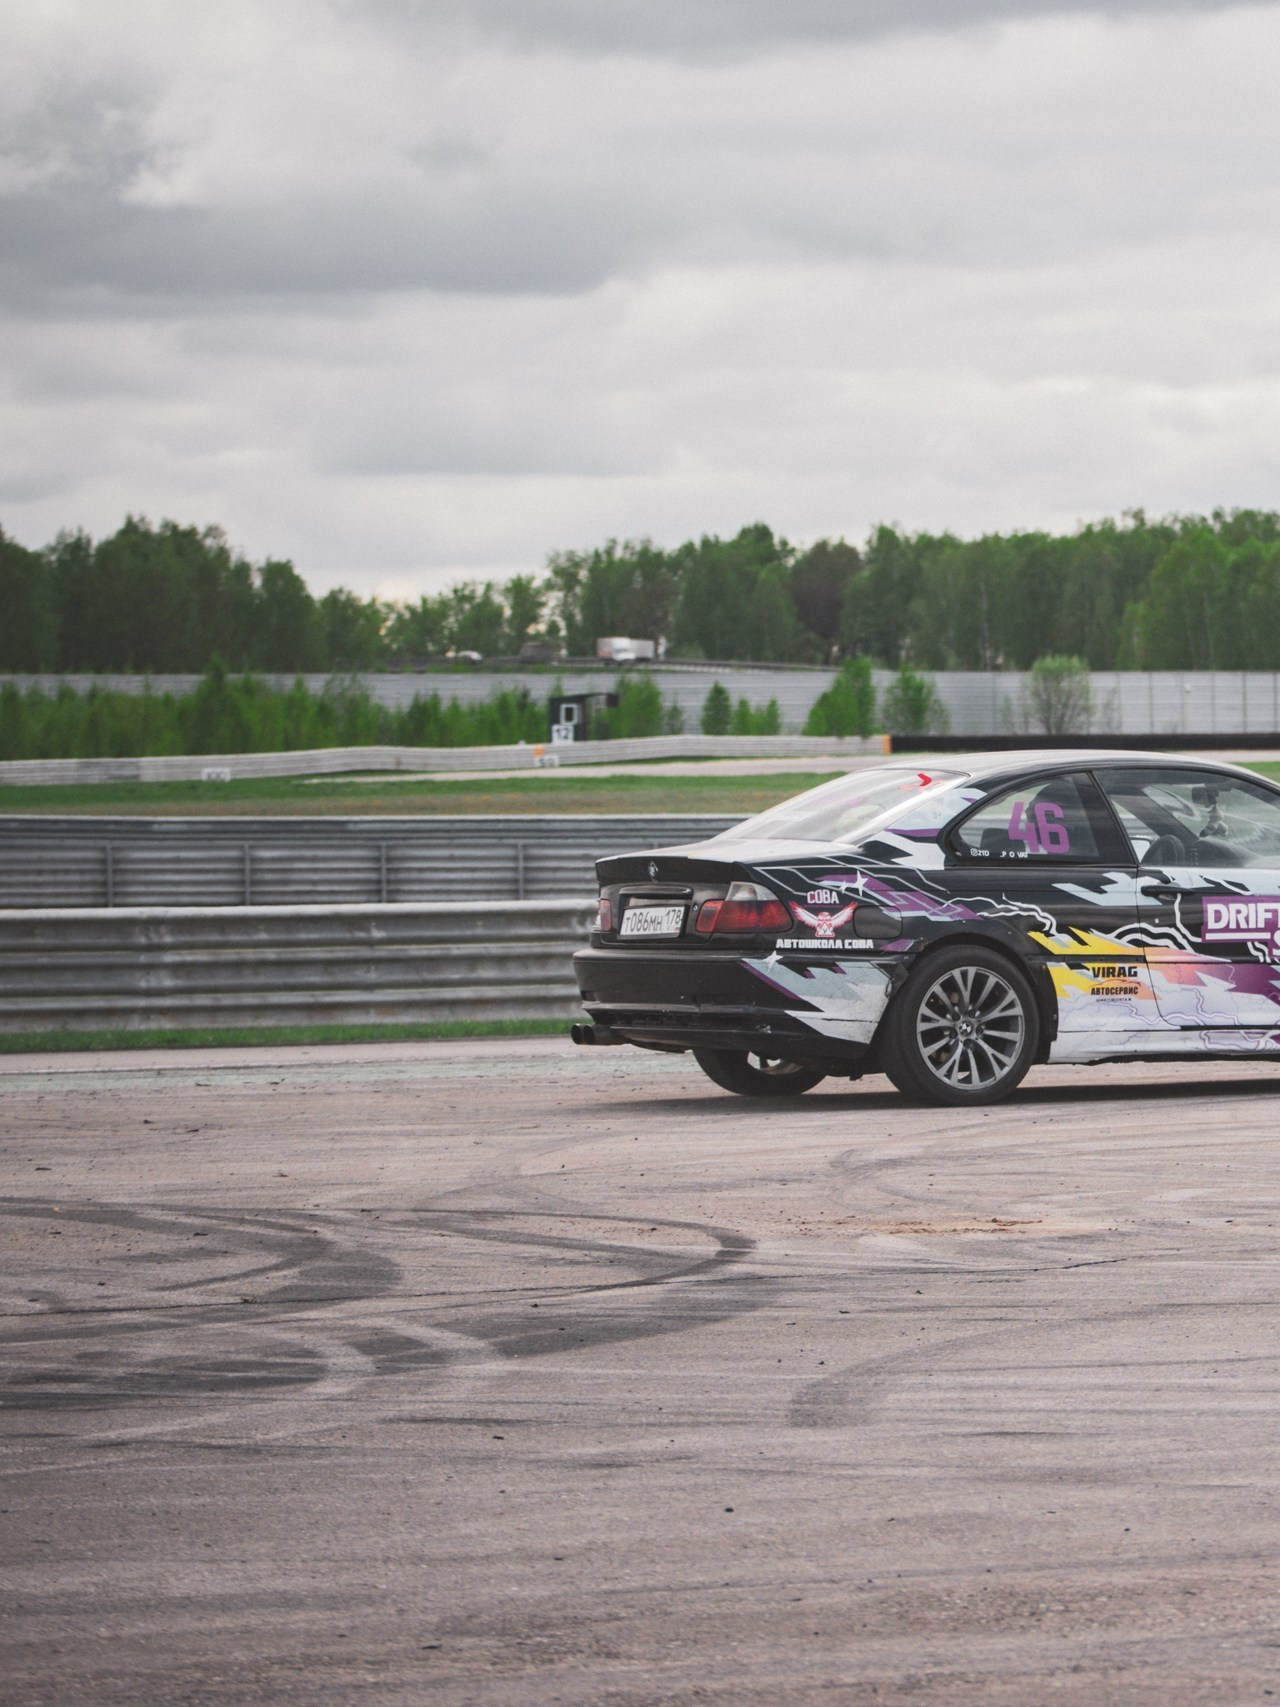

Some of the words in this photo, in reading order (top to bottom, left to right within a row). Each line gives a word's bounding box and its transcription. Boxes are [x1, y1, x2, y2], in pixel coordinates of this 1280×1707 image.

[1008, 801, 1070, 854] 46
[806, 889, 840, 904] СОВА
[665, 908, 682, 925] 178
[775, 938, 843, 949] АВТОШКОЛА
[844, 938, 874, 949] СОВА
[1091, 966, 1138, 979] VIRAG
[1090, 986, 1139, 996] АВТОСЕРВИС
